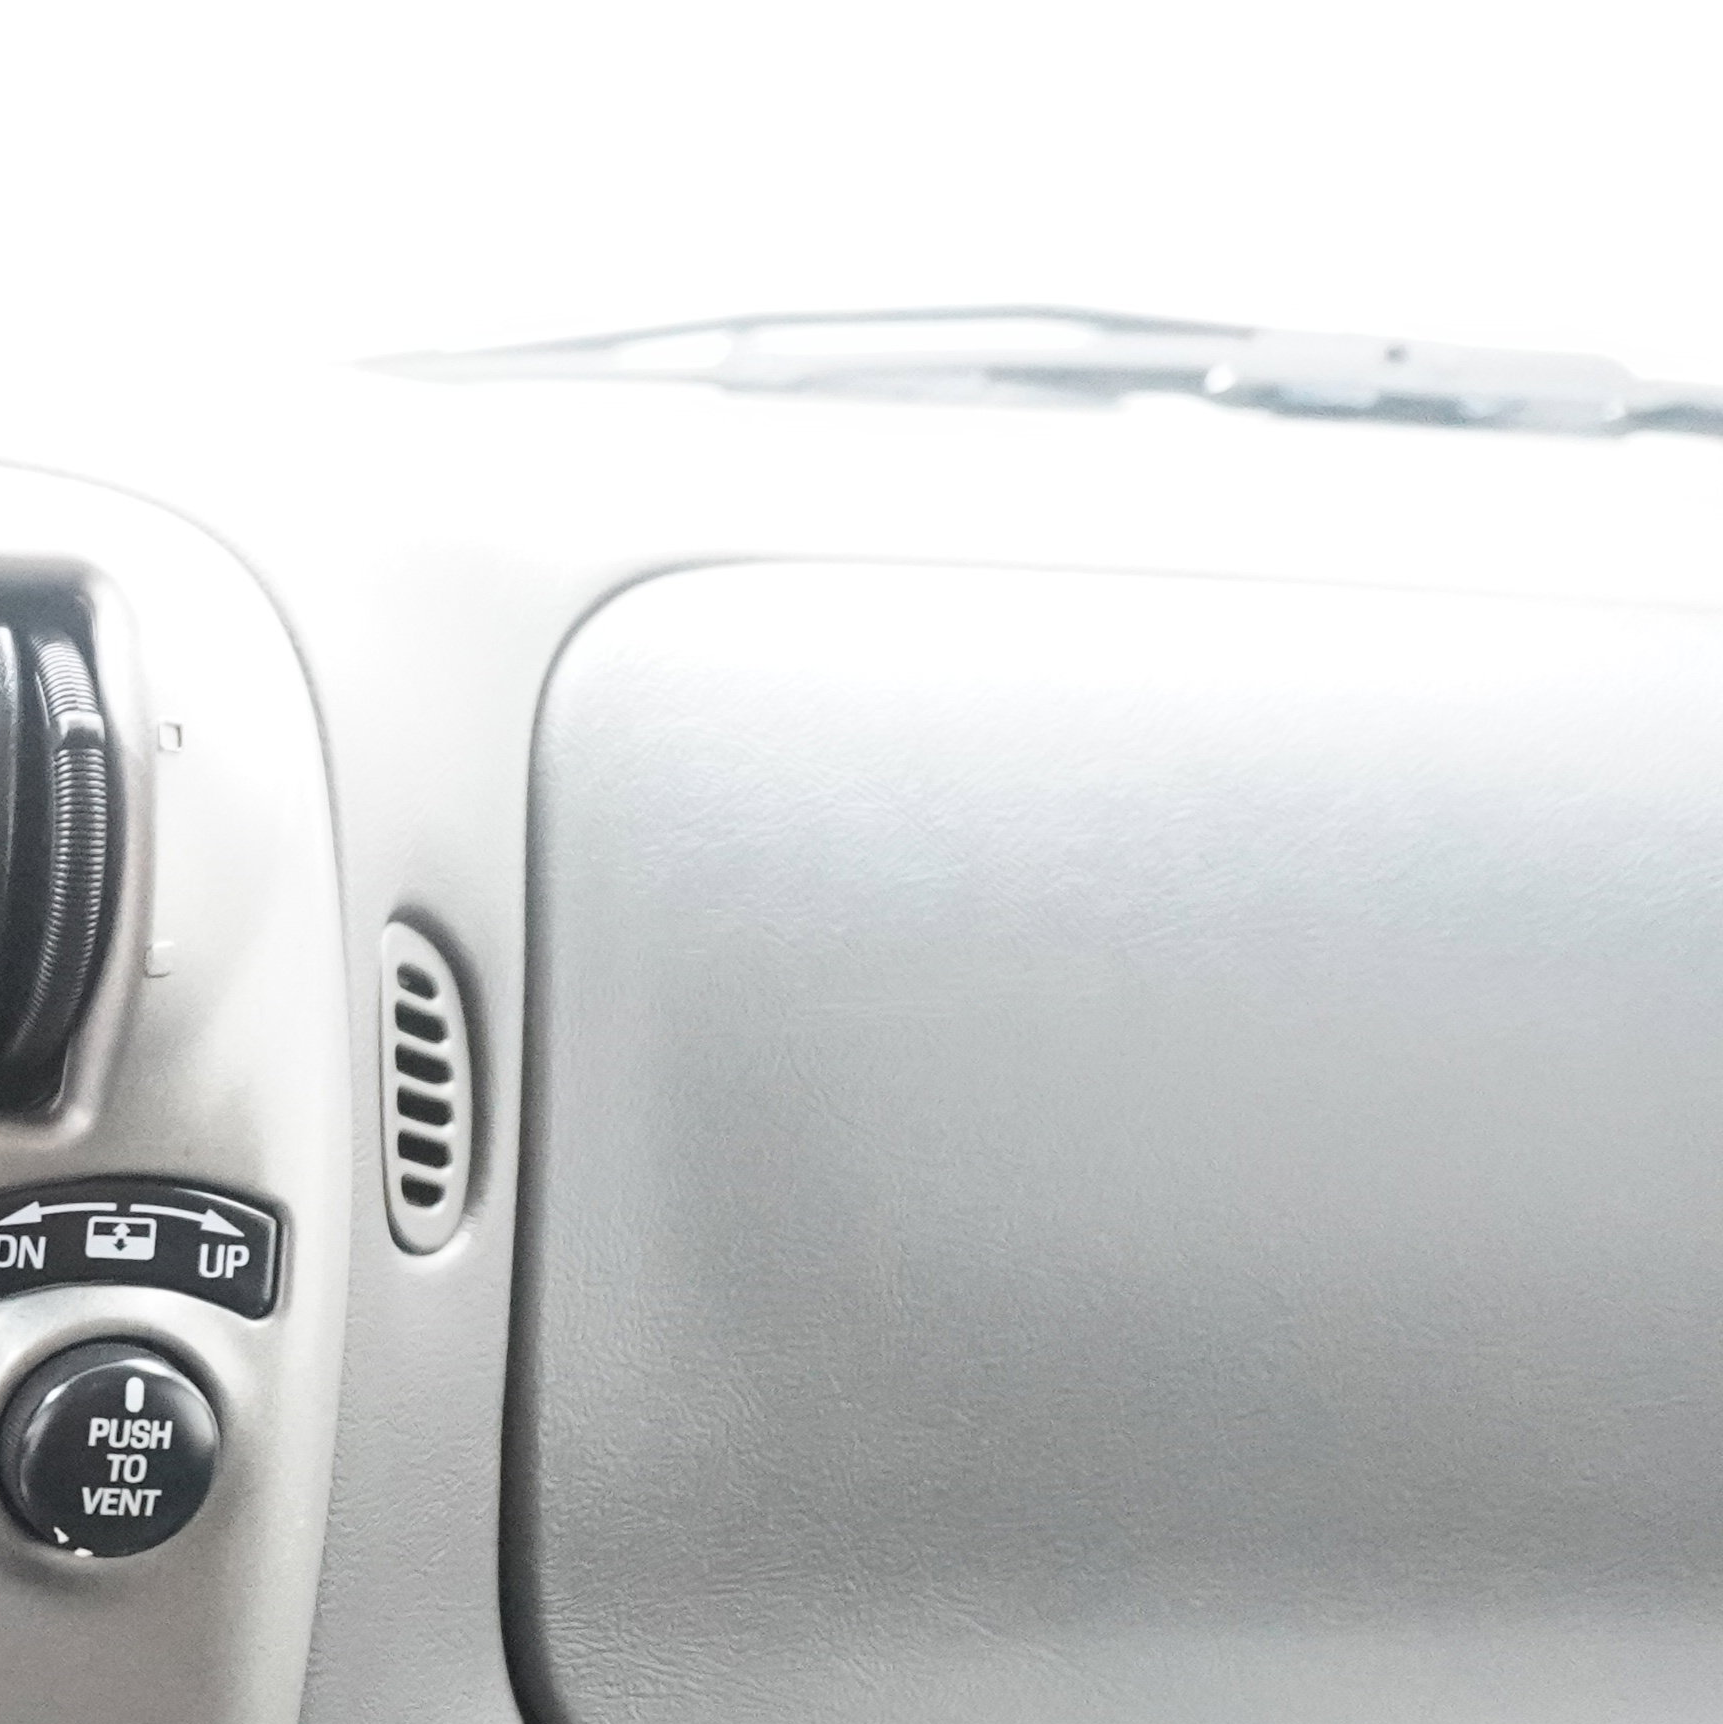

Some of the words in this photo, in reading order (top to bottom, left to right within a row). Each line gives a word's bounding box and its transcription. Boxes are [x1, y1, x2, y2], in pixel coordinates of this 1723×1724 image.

[197, 1243, 251, 1279] UP
[87, 1418, 173, 1450] PUSH
[106, 1454, 148, 1484] TO
[81, 1487, 162, 1517] VENT
